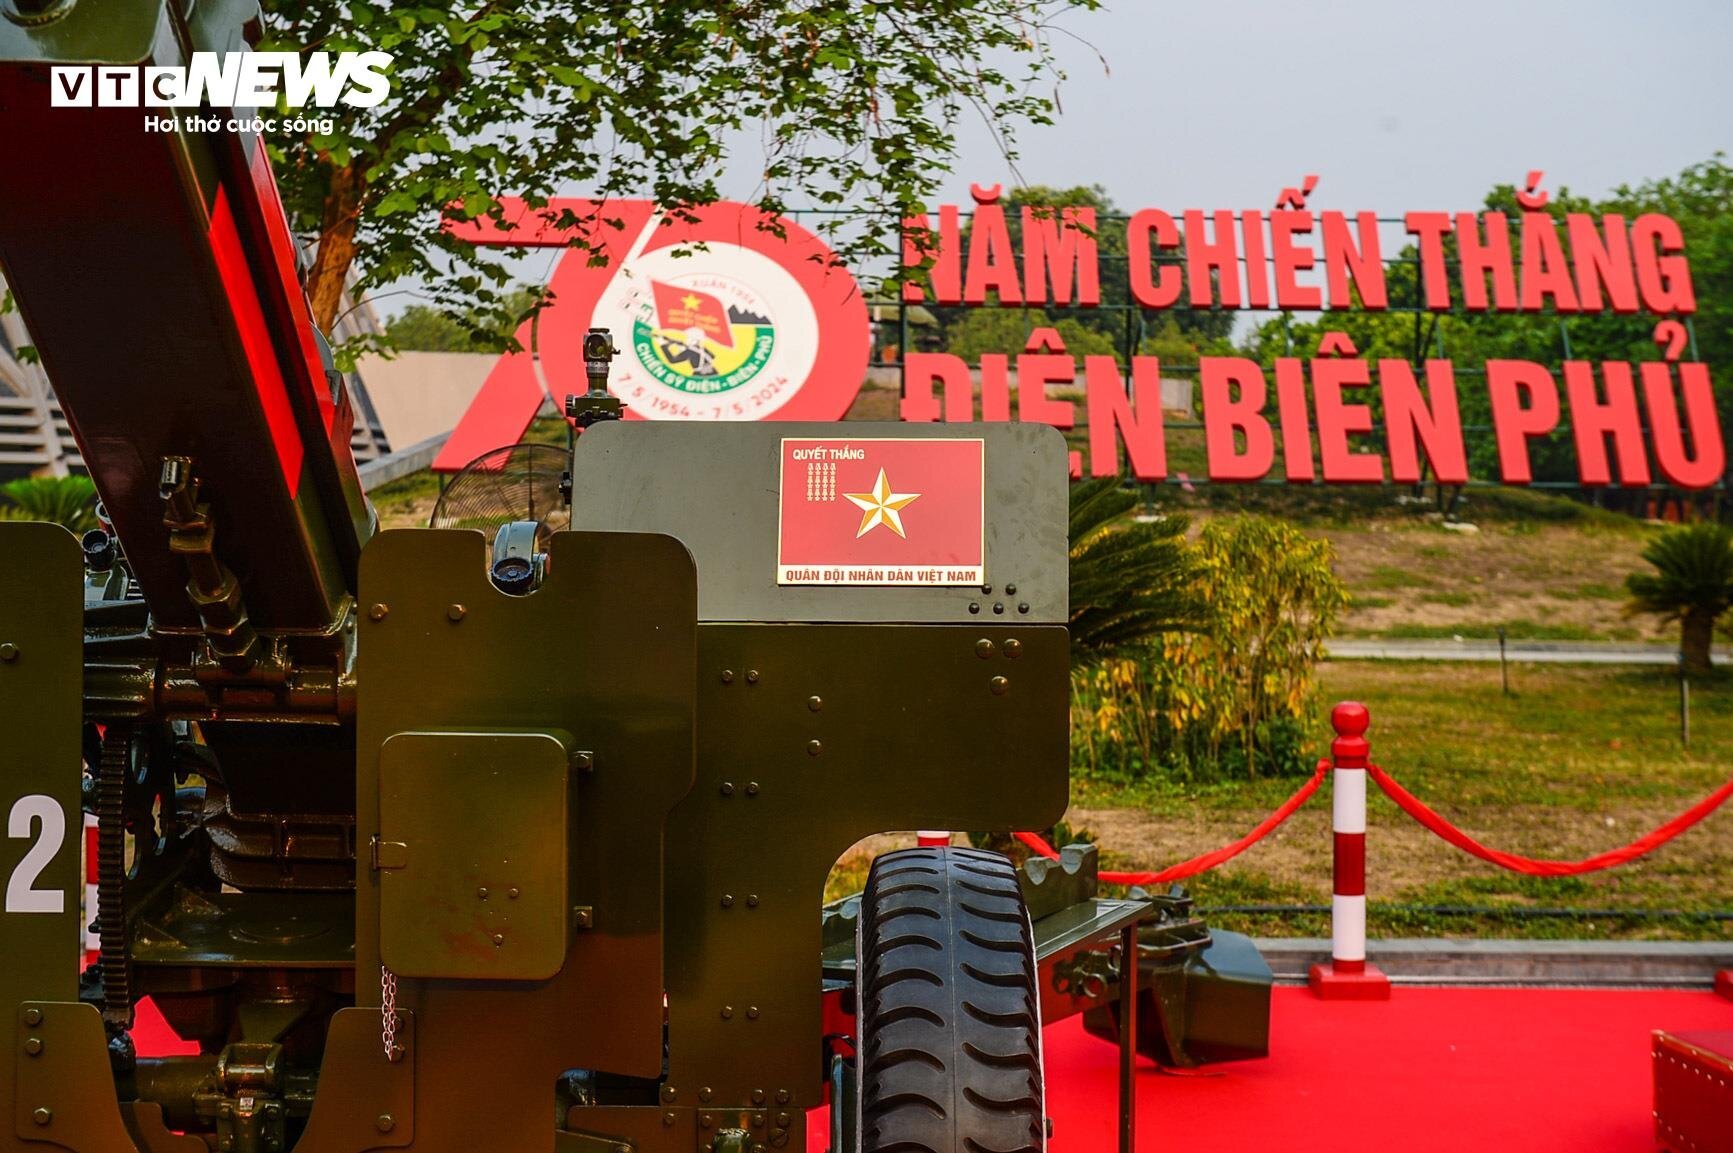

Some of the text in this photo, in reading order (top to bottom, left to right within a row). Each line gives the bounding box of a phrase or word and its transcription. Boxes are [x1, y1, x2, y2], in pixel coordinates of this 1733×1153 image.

[901, 171, 1696, 316] NĂM CHIẾN THẮNG
[792, 444, 865, 461] QUYẾT THẮNG
[1200, 331, 1468, 482] BIÊN
[1486, 320, 1725, 488] PHỦ
[785, 568, 976, 584] QUÂN ĐỘI NHÂN DÂN VIỆT NAM
[5, 795, 66, 914] 2
